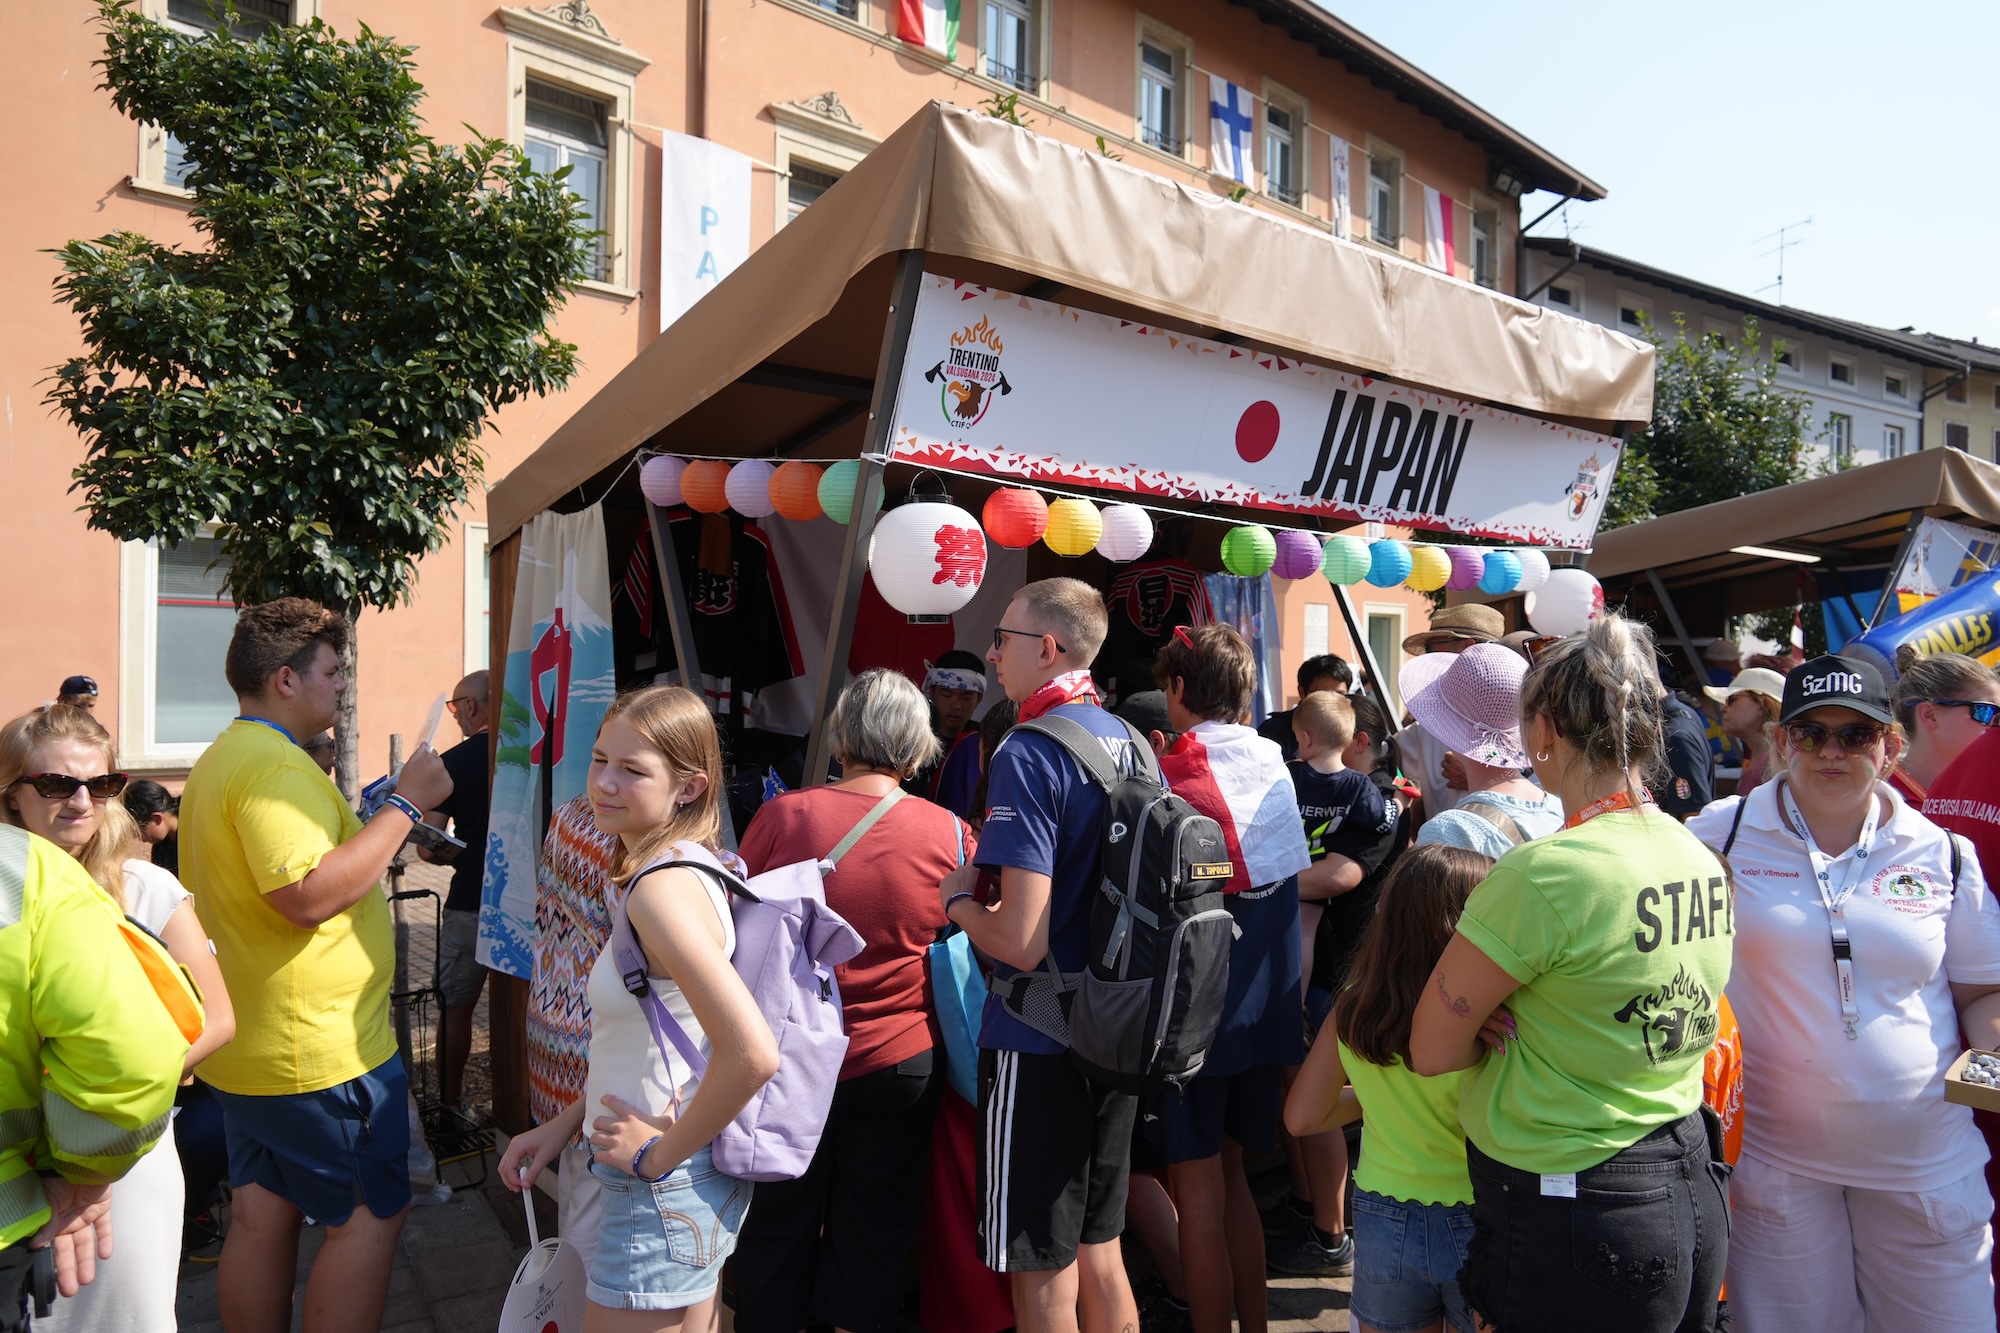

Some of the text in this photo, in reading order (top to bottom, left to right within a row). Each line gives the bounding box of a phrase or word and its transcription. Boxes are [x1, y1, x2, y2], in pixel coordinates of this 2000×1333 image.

[949, 347, 1000, 372] TRENTINO
[946, 365, 996, 382] VALSUGANA 2024
[951, 420, 966, 428] CTIF
[1300, 388, 1474, 516] JAPAN
[1802, 671, 1863, 697] SzMG
[1938, 798, 1960, 816] ROSA
[1959, 799, 2000, 826] ITALIANA
[1691, 1012, 1718, 1041] TREN
